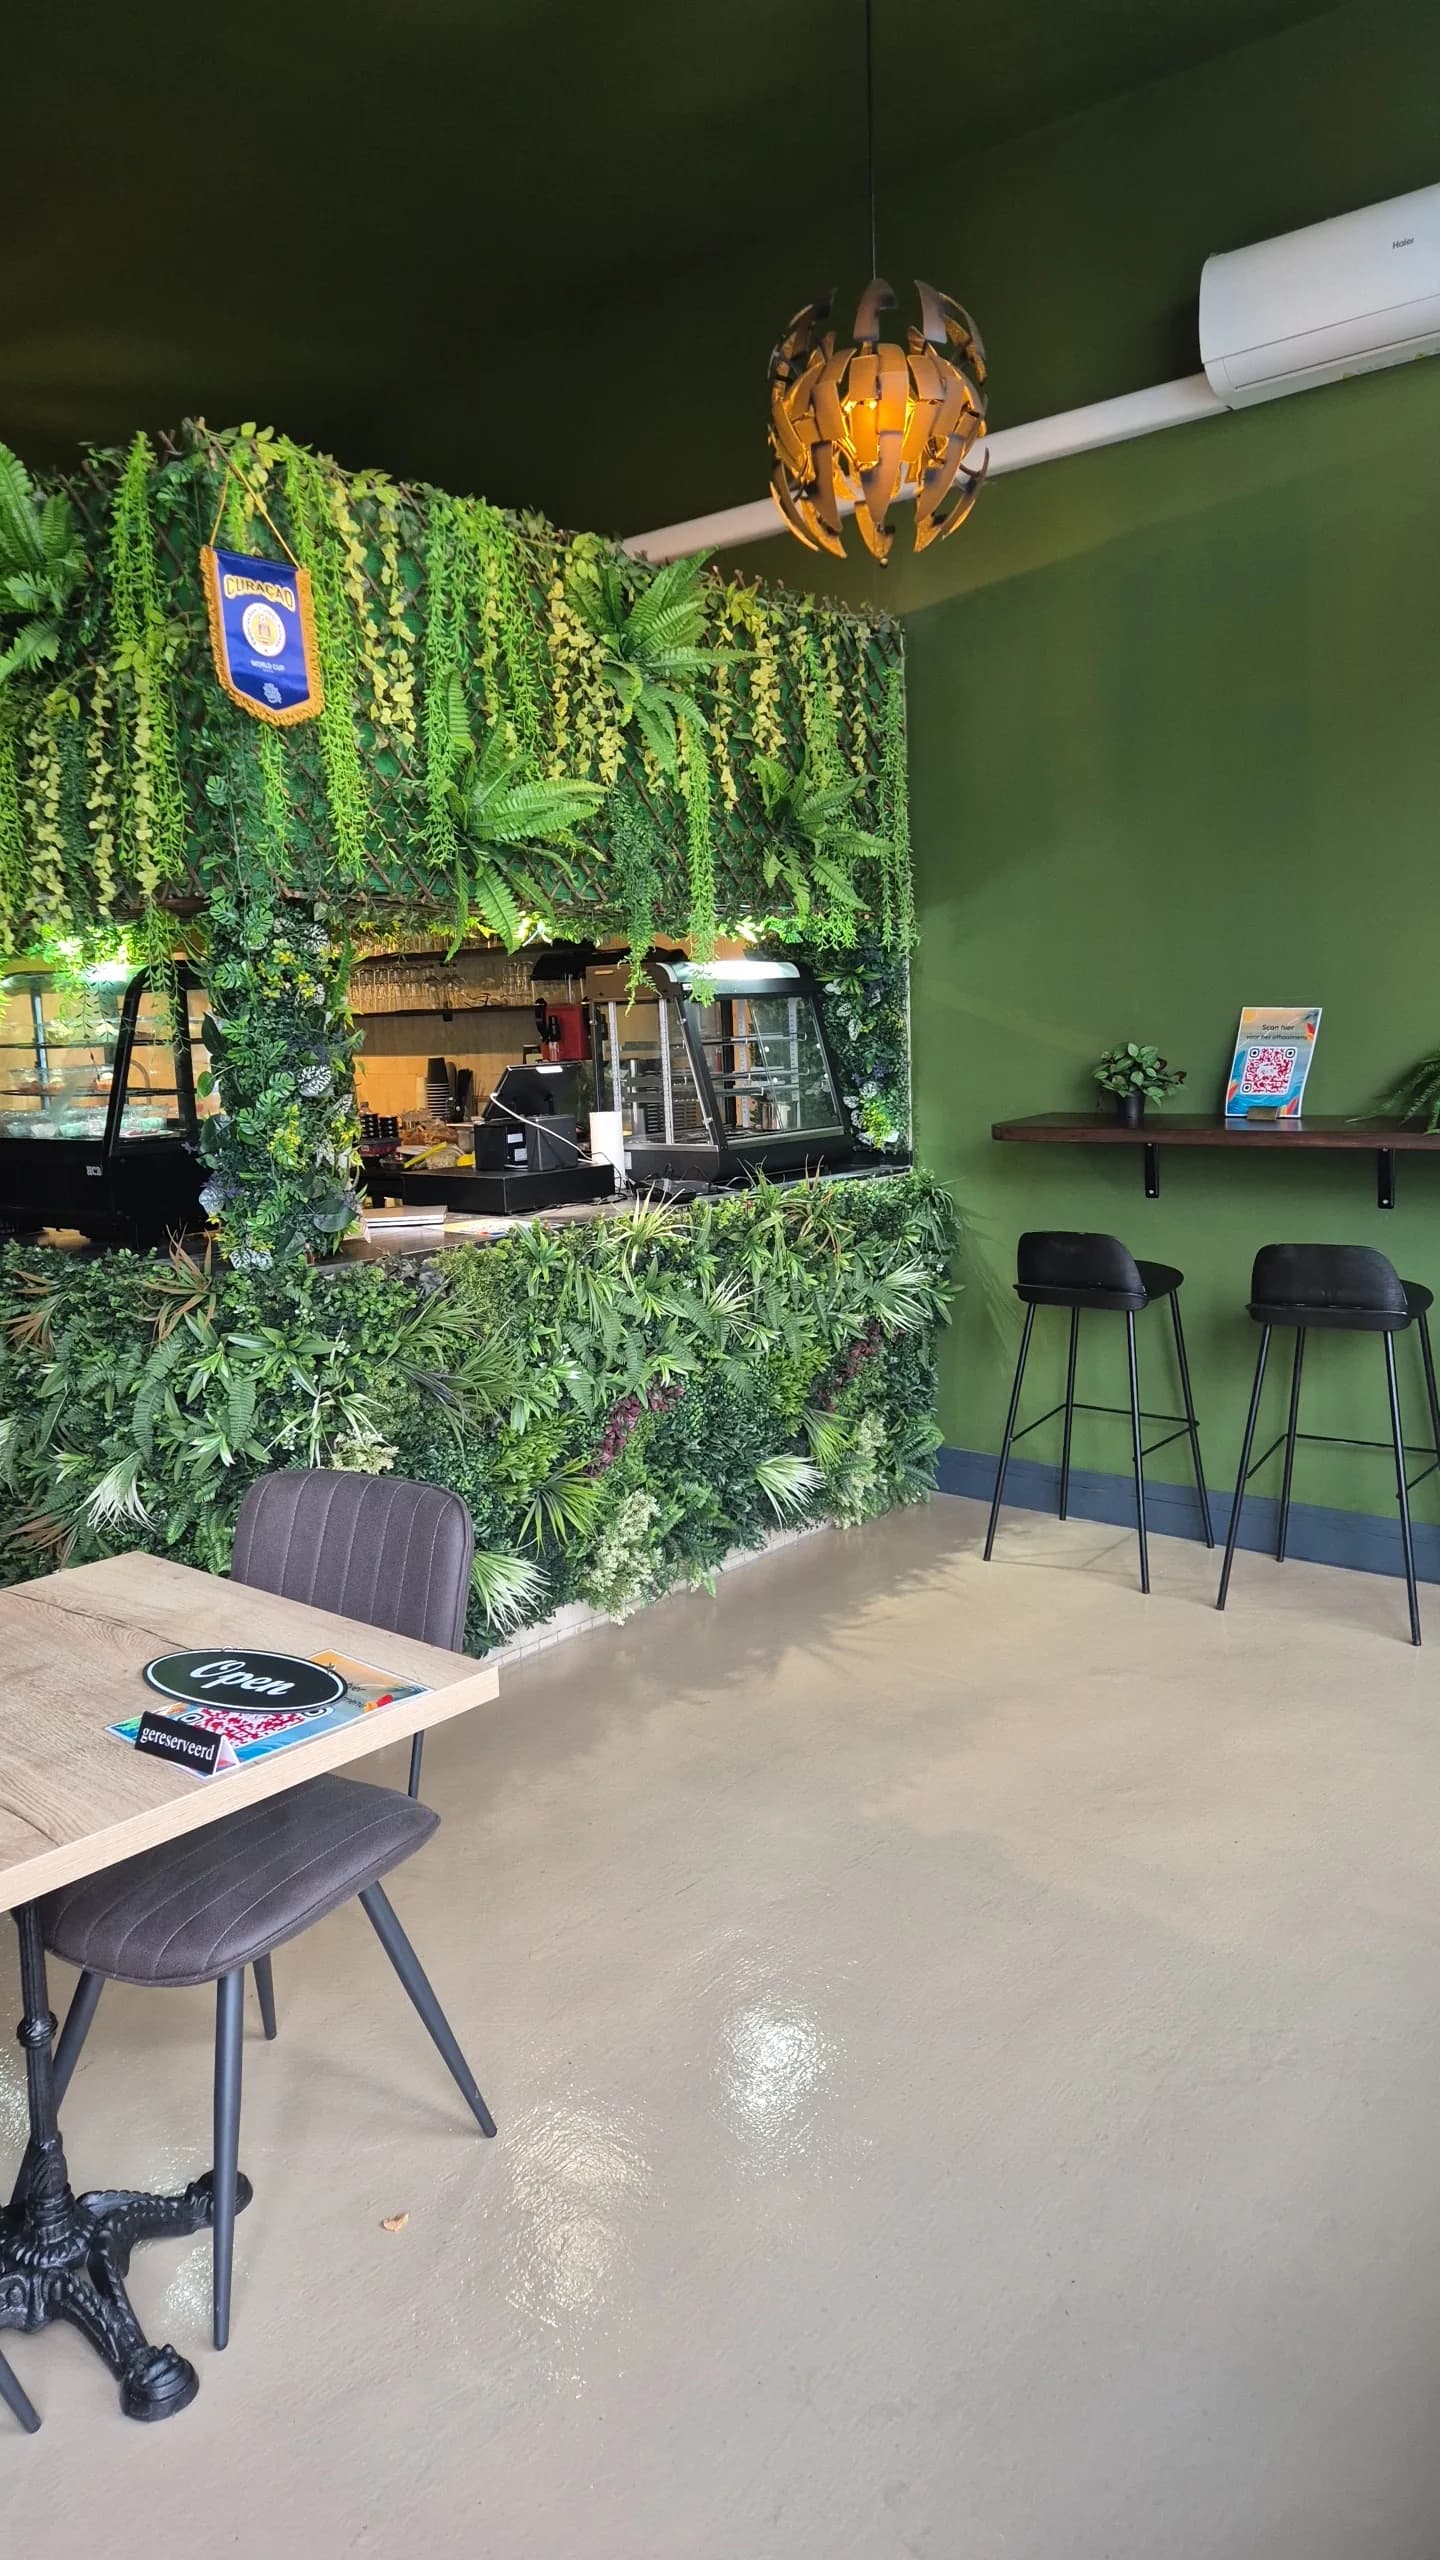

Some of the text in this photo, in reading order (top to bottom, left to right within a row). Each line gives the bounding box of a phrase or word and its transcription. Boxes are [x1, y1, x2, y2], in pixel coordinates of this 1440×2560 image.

[1392, 238, 1415, 249] Haier
[224, 574, 296, 612] CURAÇAO
[251, 660, 273, 669] WORLD
[190, 1660, 295, 1695] Open
[140, 1727, 215, 1761] gereserveerd
